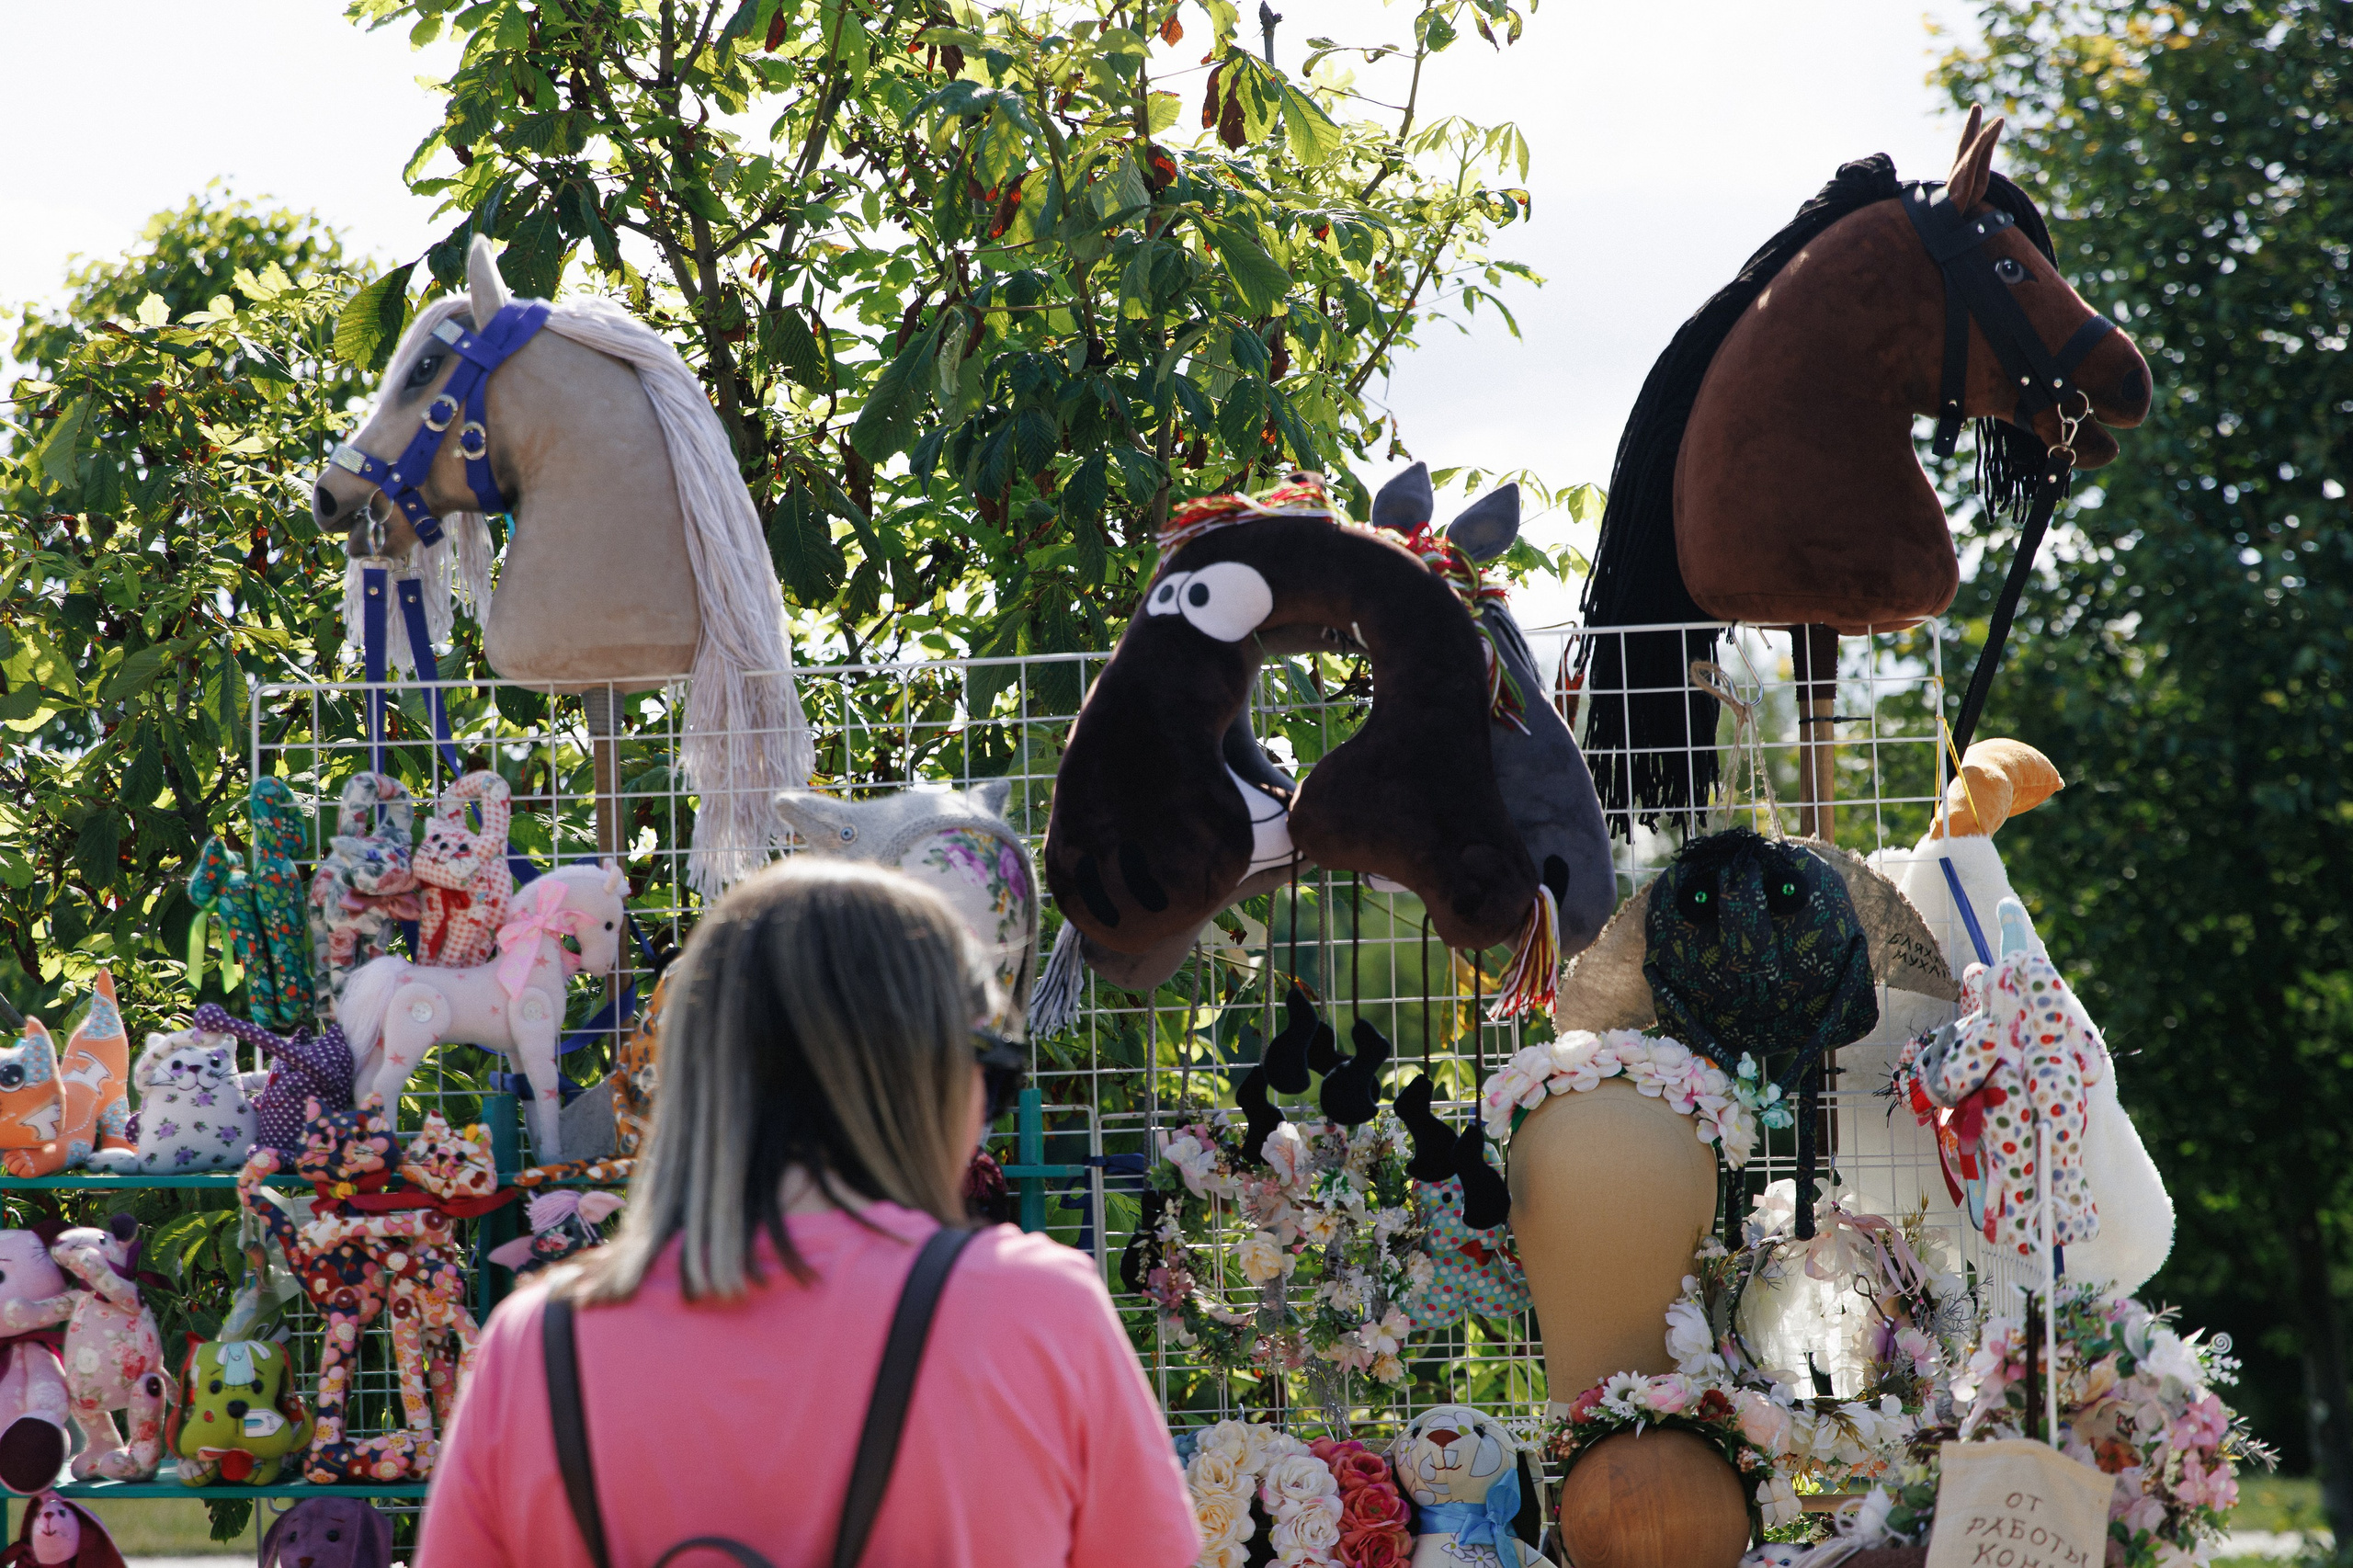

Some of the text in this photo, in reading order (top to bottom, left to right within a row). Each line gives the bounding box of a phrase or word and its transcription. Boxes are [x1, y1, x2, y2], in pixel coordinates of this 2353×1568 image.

[2005, 1492, 2042, 1512] ОТ
[1965, 1517, 2088, 1568] РАБОТЫ
[1972, 1543, 2054, 1568] КОН
